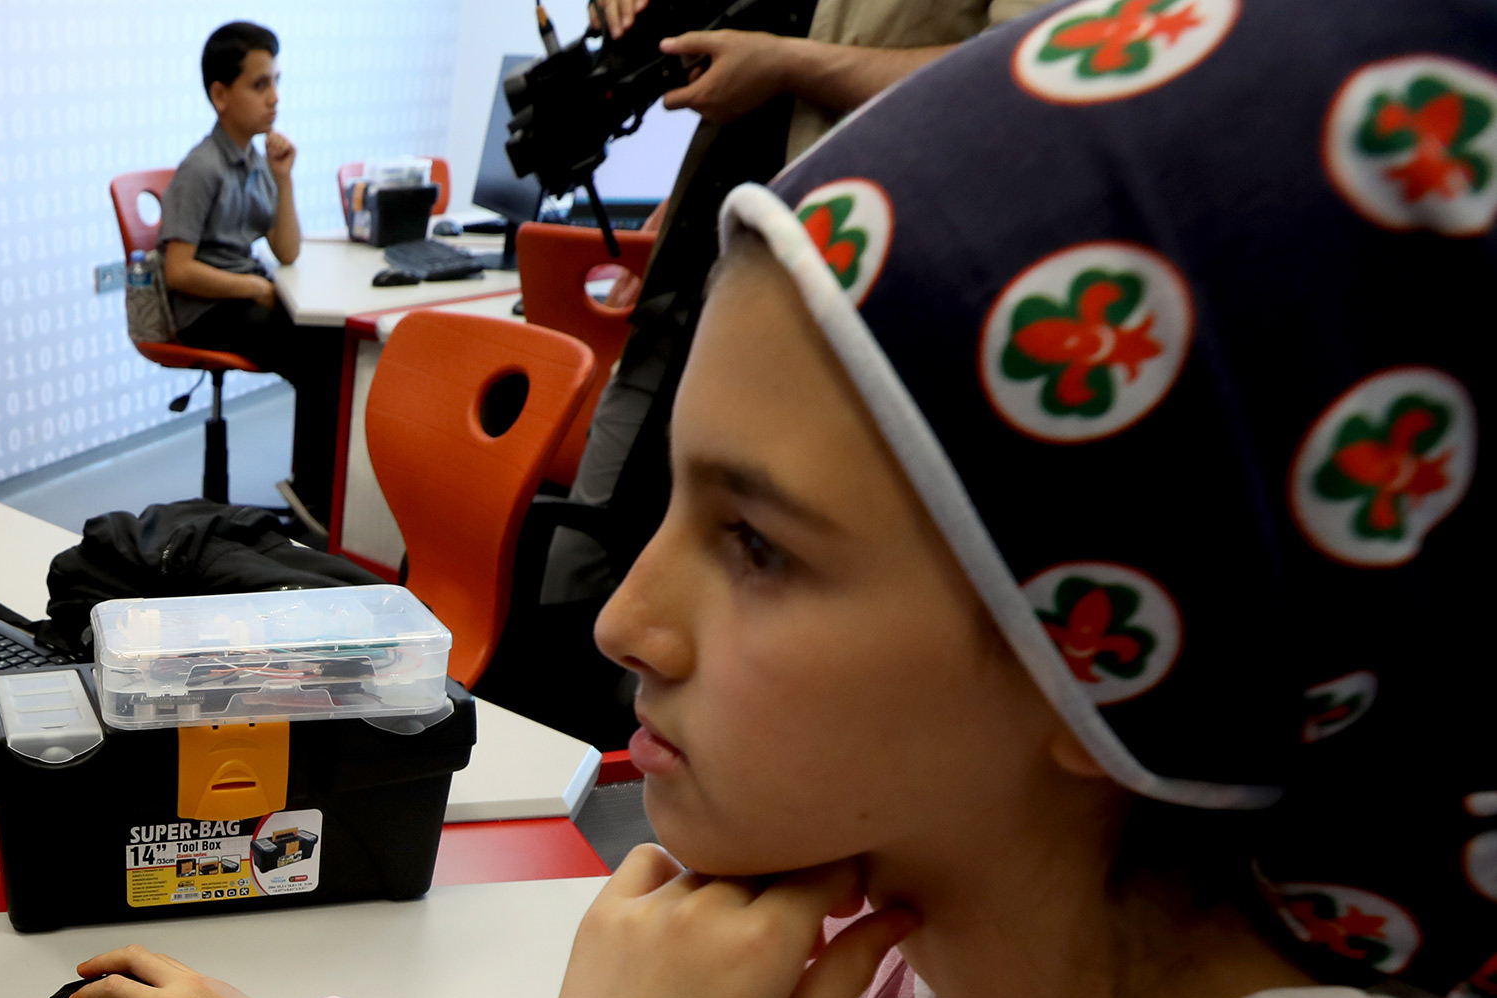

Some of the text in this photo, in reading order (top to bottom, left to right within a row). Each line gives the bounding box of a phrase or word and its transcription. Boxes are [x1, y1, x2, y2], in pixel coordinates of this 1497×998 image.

[130, 819, 241, 843] SUPER-BAG
[176, 840, 222, 853] Tool Box
